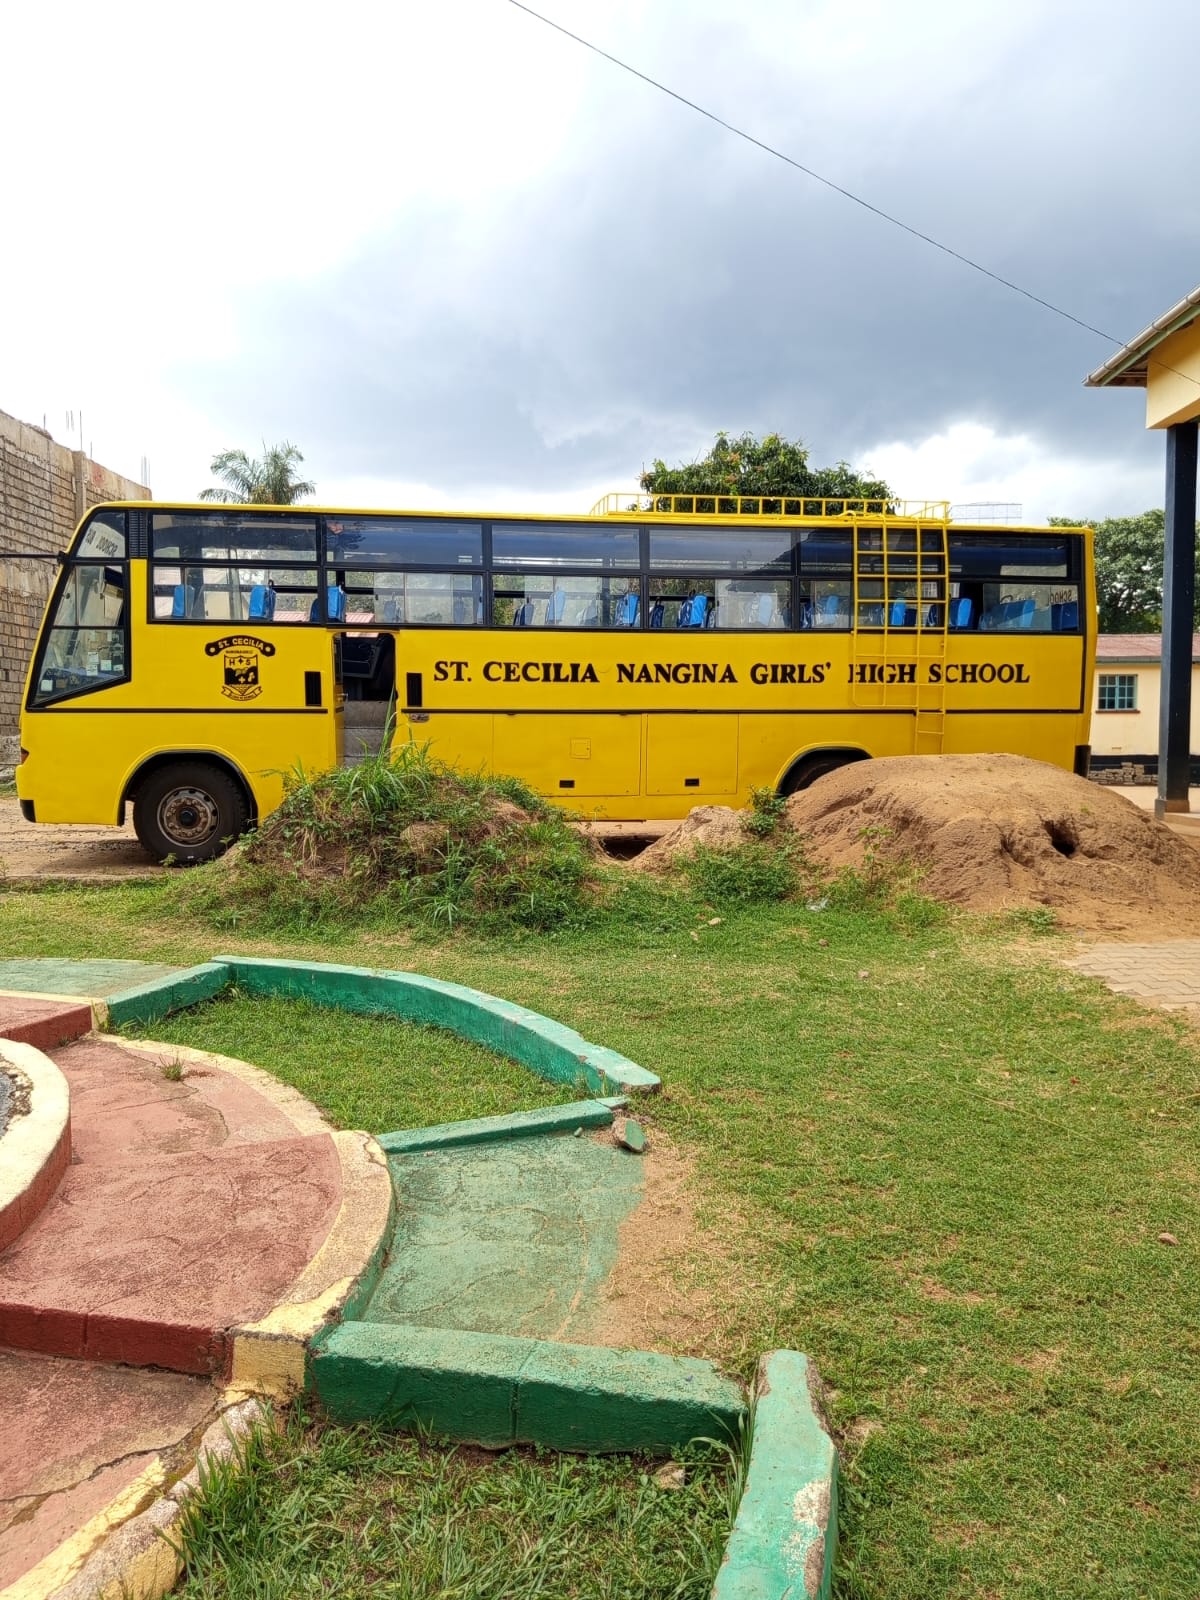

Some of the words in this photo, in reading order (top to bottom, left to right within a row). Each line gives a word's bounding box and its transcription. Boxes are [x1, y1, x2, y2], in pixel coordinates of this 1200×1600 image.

[218, 640, 230, 649] ST.
[232, 638, 264, 650] CECILIA
[434, 660, 472, 682] ST.
[482, 661, 600, 683] CECILIA
[616, 663, 738, 684] NANGINA
[750, 661, 831, 685] GIRLS'
[848, 663, 917, 684] HIGH
[928, 663, 1031, 684] SCHOOL
